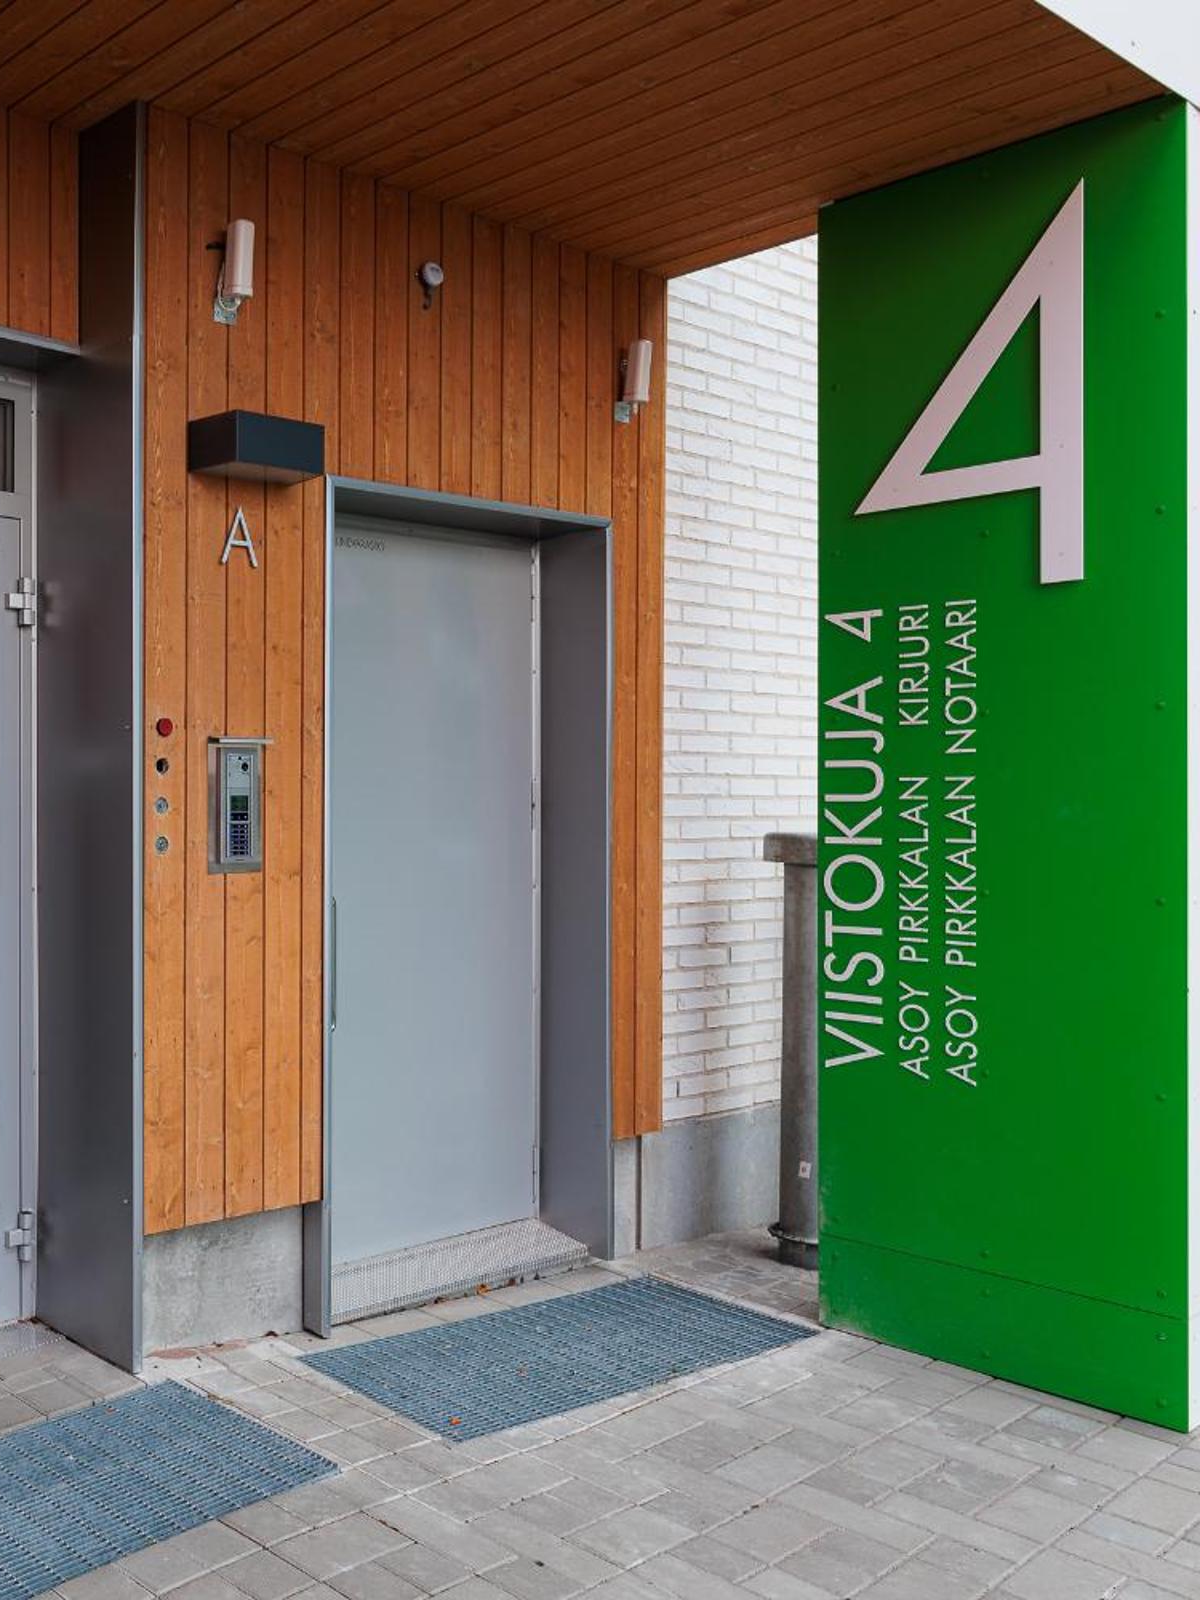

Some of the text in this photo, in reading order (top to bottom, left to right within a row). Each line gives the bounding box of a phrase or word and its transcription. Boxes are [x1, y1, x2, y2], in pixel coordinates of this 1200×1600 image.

[221, 506, 258, 568] A
[855, 177, 1085, 584] 4
[824, 608, 885, 1068] VIISTOKUJA 4
[899, 604, 930, 1079] ASOY PIRKKALAN KIRJURI
[945, 600, 978, 1087] ASOY PIRKKALAN NOTAARI
